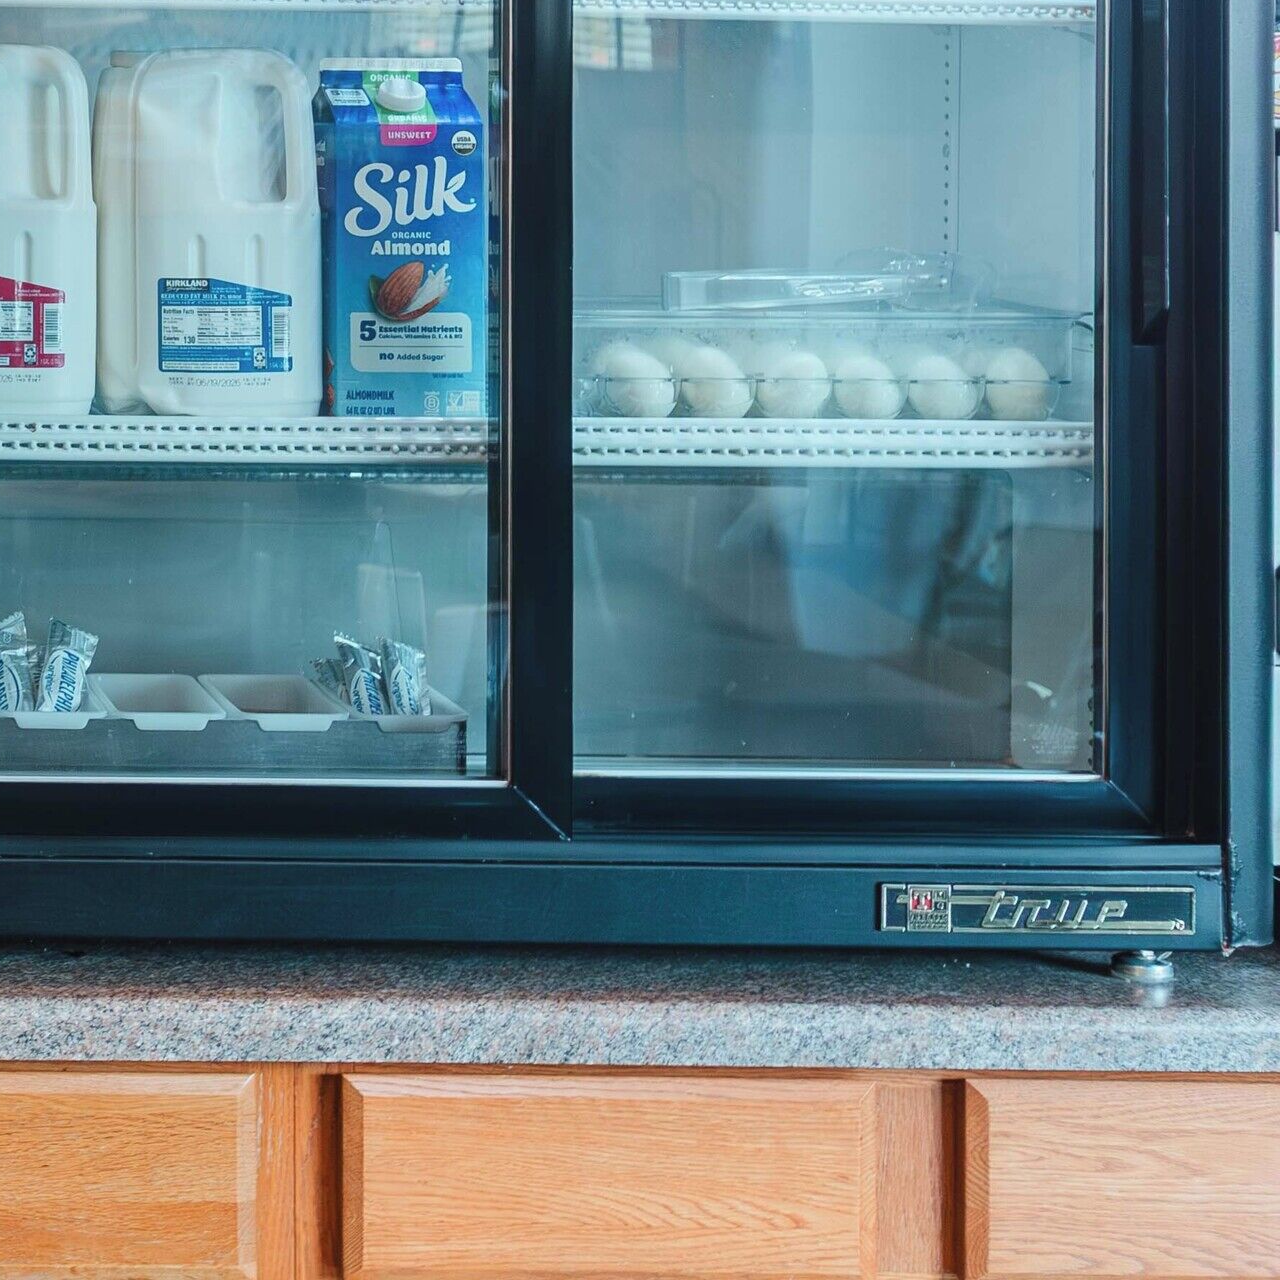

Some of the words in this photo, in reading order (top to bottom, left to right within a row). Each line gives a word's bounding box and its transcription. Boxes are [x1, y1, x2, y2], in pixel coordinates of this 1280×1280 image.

[388, 131, 433, 140] UNSWEET
[344, 155, 477, 237] Silk
[391, 231, 432, 239] ORGANIC
[371, 240, 451, 256] Almond
[360, 320, 377, 341] 5
[378, 325, 419, 333] Essential
[421, 325, 463, 333] Nutrients
[183, 336, 196, 344] 130
[379, 352, 394, 360] no
[422, 354, 444, 362] Sugar
[346, 390, 394, 400] ALMONDMILK
